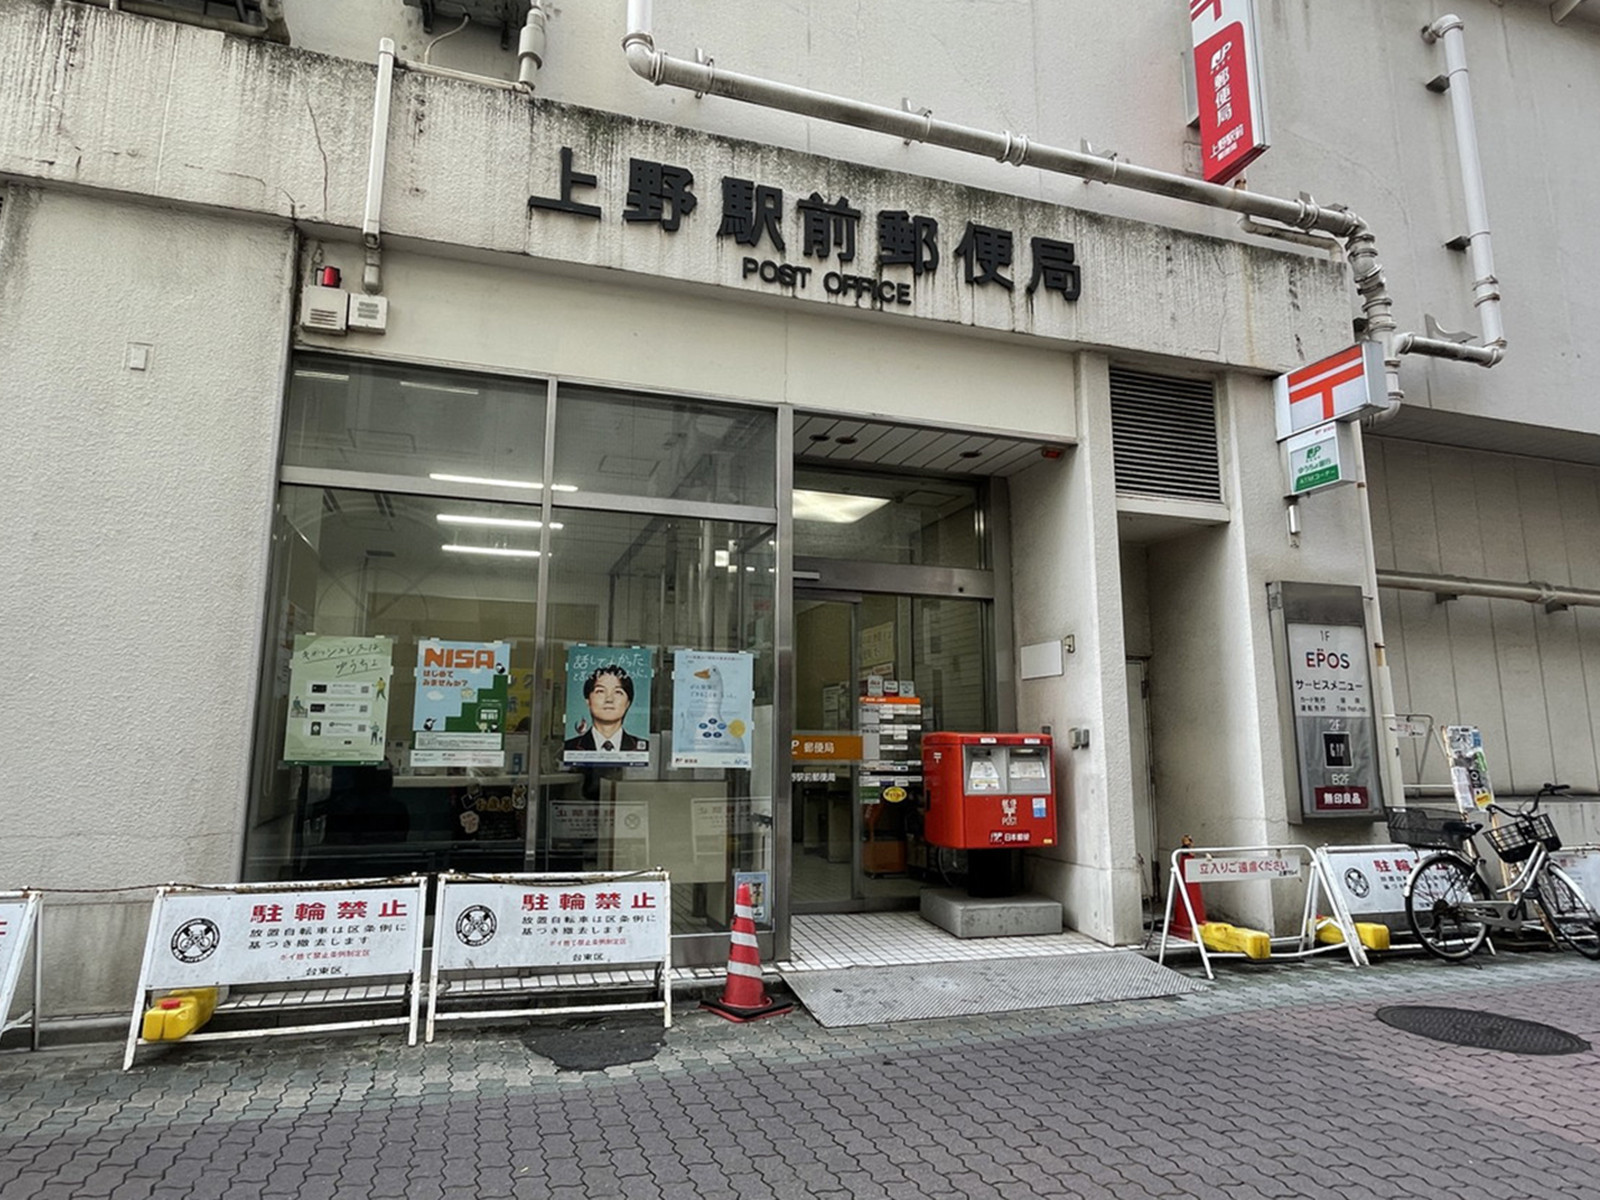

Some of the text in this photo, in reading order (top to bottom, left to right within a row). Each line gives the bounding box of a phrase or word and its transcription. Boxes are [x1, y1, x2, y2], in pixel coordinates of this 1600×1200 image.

[1214, 66, 1232, 128] 郵便局
[528, 146, 1081, 302] 上野駅前郵便局
[743, 257, 912, 305] POST OFFICE
[1320, 630, 1330, 641] 1F
[423, 648, 495, 669] NISA
[423, 670, 454, 678] はじめて
[1295, 680, 1363, 691] サービスメニュー
[804, 741, 835, 754] 郵便局
[1331, 773, 1349, 785] B2F
[1199, 860, 1289, 875] 立入りご遠慮ください
[521, 892, 657, 911] 駐輪禁止
[250, 899, 408, 923] 駐輪禁止
[521, 915, 656, 925] 放置自転車は区条例に
[249, 923, 406, 938] 放置自転車は区条例に
[306, 966, 342, 976] 台東区
